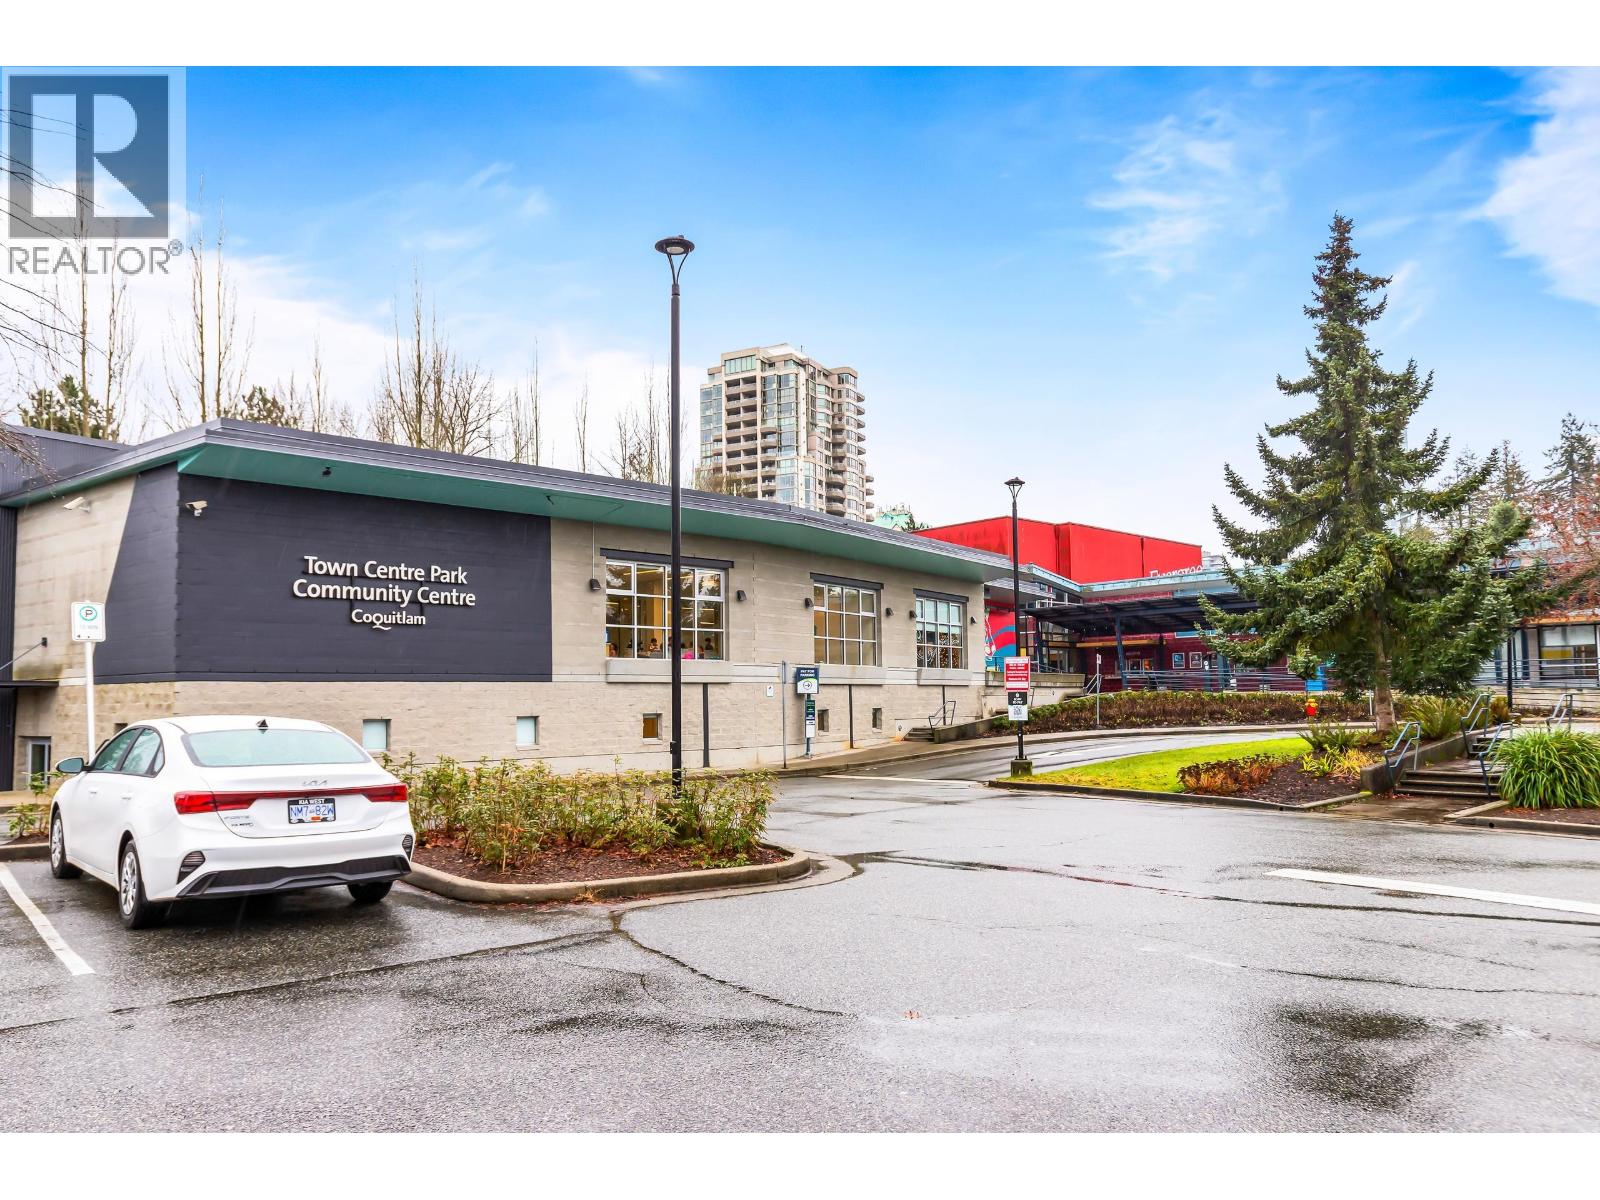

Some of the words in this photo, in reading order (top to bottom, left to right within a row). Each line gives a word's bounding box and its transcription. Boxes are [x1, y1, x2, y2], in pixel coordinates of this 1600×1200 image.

[304, 555, 358, 577] Town
[364, 560, 425, 581] Centre
[430, 565, 468, 585] Park
[293, 579, 412, 608] Community
[417, 586, 476, 606] Centre
